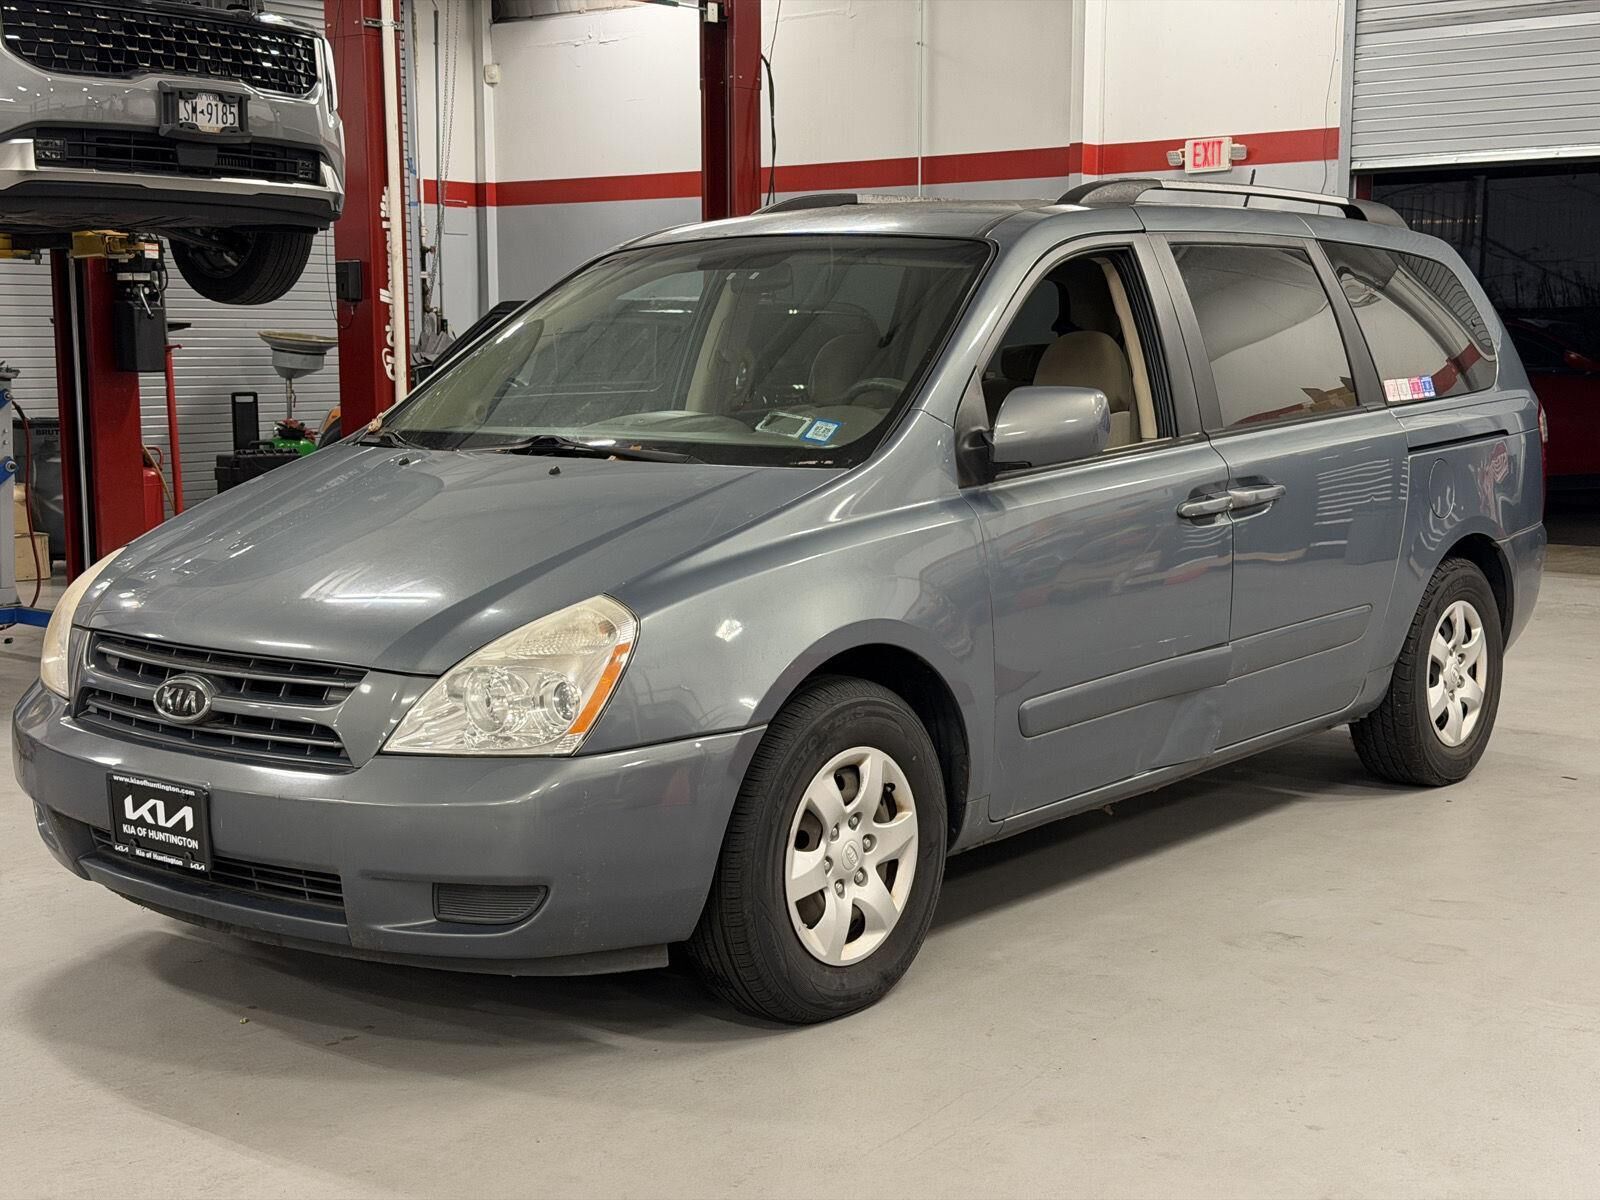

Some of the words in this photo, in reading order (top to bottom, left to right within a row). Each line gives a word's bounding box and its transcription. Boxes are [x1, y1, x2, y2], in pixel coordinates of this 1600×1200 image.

[1193, 140, 1223, 168] EXIT
[161, 686, 197, 712] KIA
[113, 775, 195, 796] www.kiaofhuntington.com
[124, 795, 194, 832] KIA
[122, 823, 136, 836] KIA
[137, 827, 147, 838] OF
[148, 830, 199, 850] HUNTINGTON
[135, 848, 146, 857] Kia
[146, 851, 153, 859] of
[153, 854, 183, 866] Huntington
